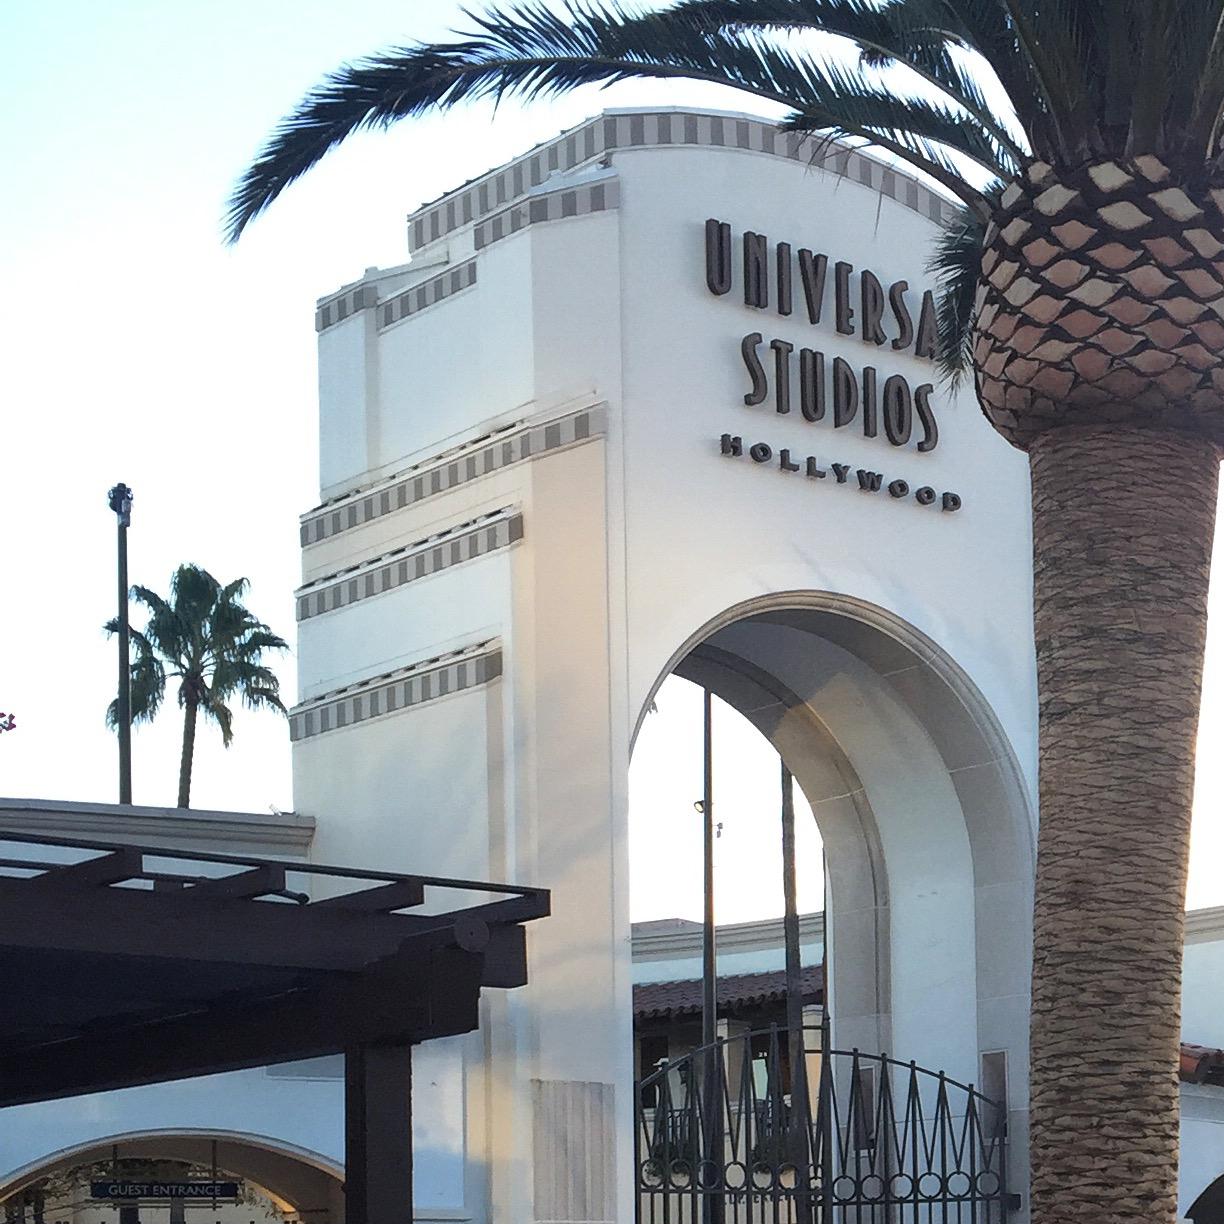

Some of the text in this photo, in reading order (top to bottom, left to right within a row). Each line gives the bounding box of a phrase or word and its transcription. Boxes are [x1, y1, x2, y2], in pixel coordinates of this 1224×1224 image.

[705, 218, 940, 361] UNIVERSA
[741, 332, 938, 452] STUDIOS
[720, 433, 962, 512] HOLLYWOOD
[108, 1184, 221, 1196] GUEST ENTRANCE
